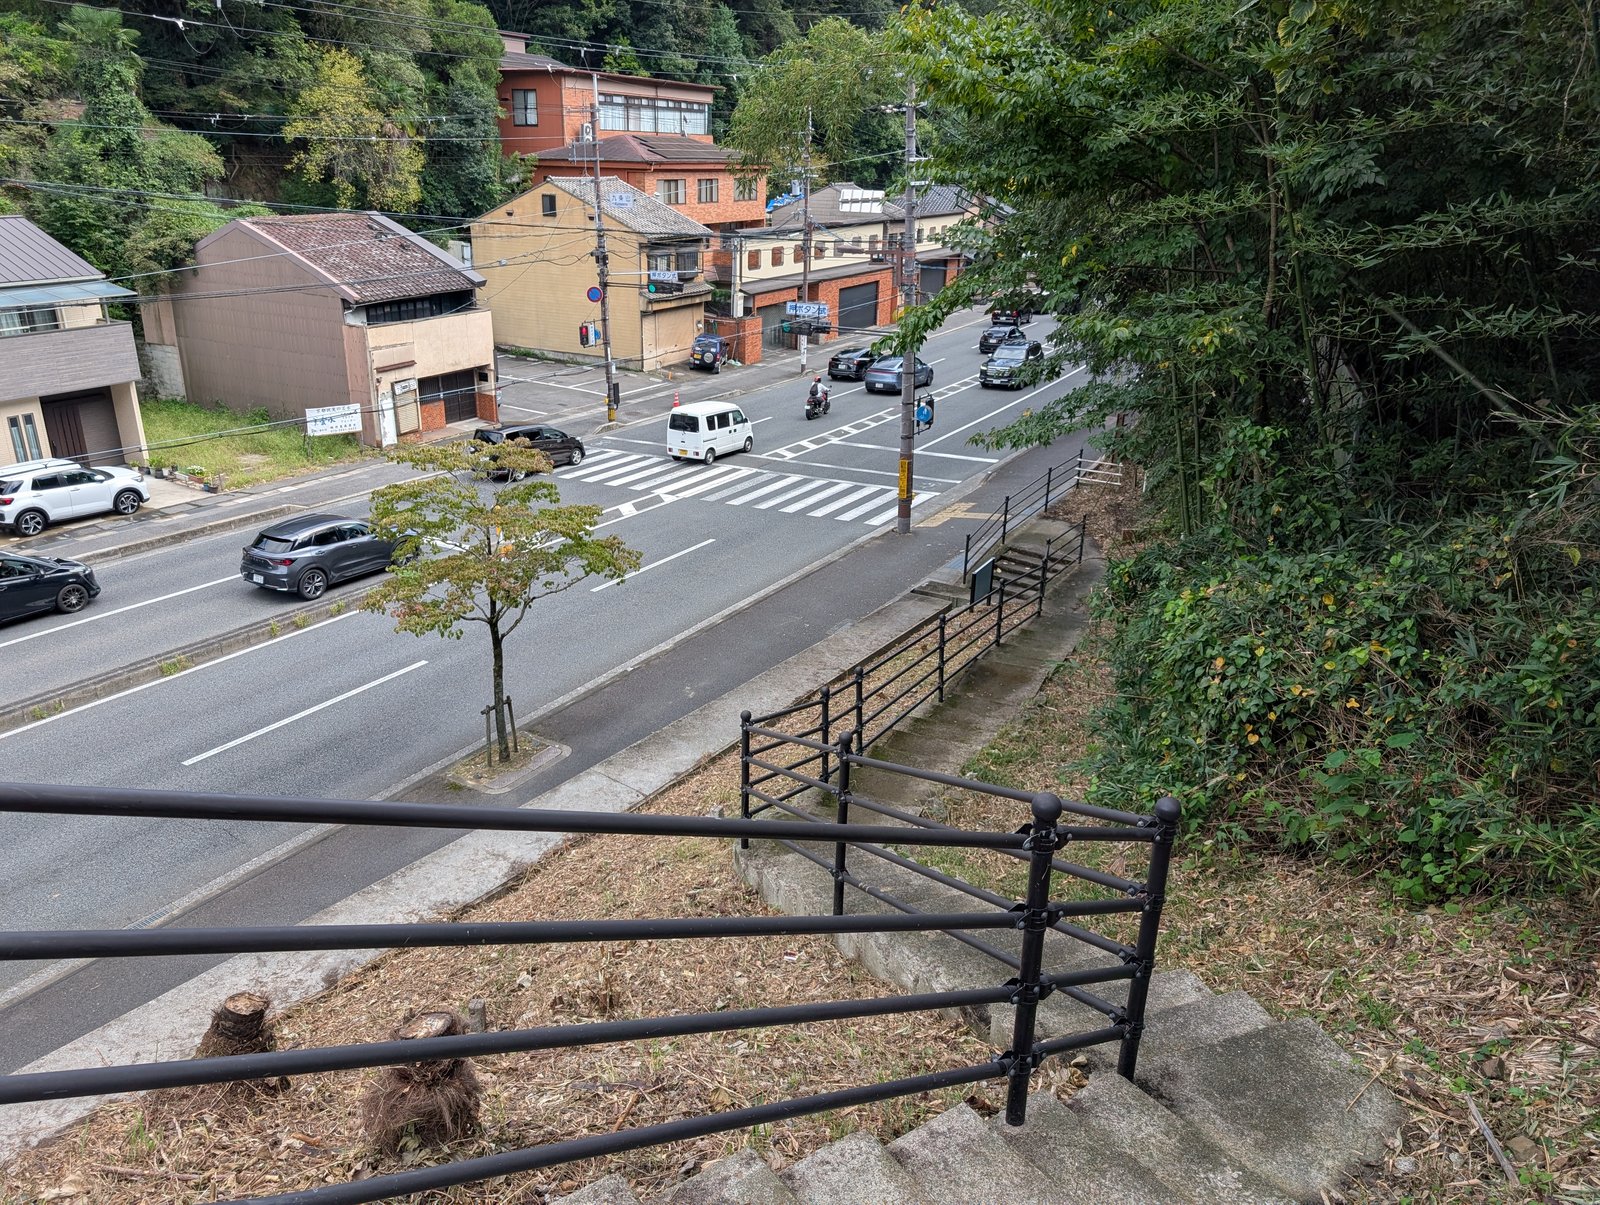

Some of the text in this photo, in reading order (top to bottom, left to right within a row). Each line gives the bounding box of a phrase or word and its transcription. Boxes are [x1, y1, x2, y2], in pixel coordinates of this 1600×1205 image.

[789, 303, 827, 315] 押ボタン式
